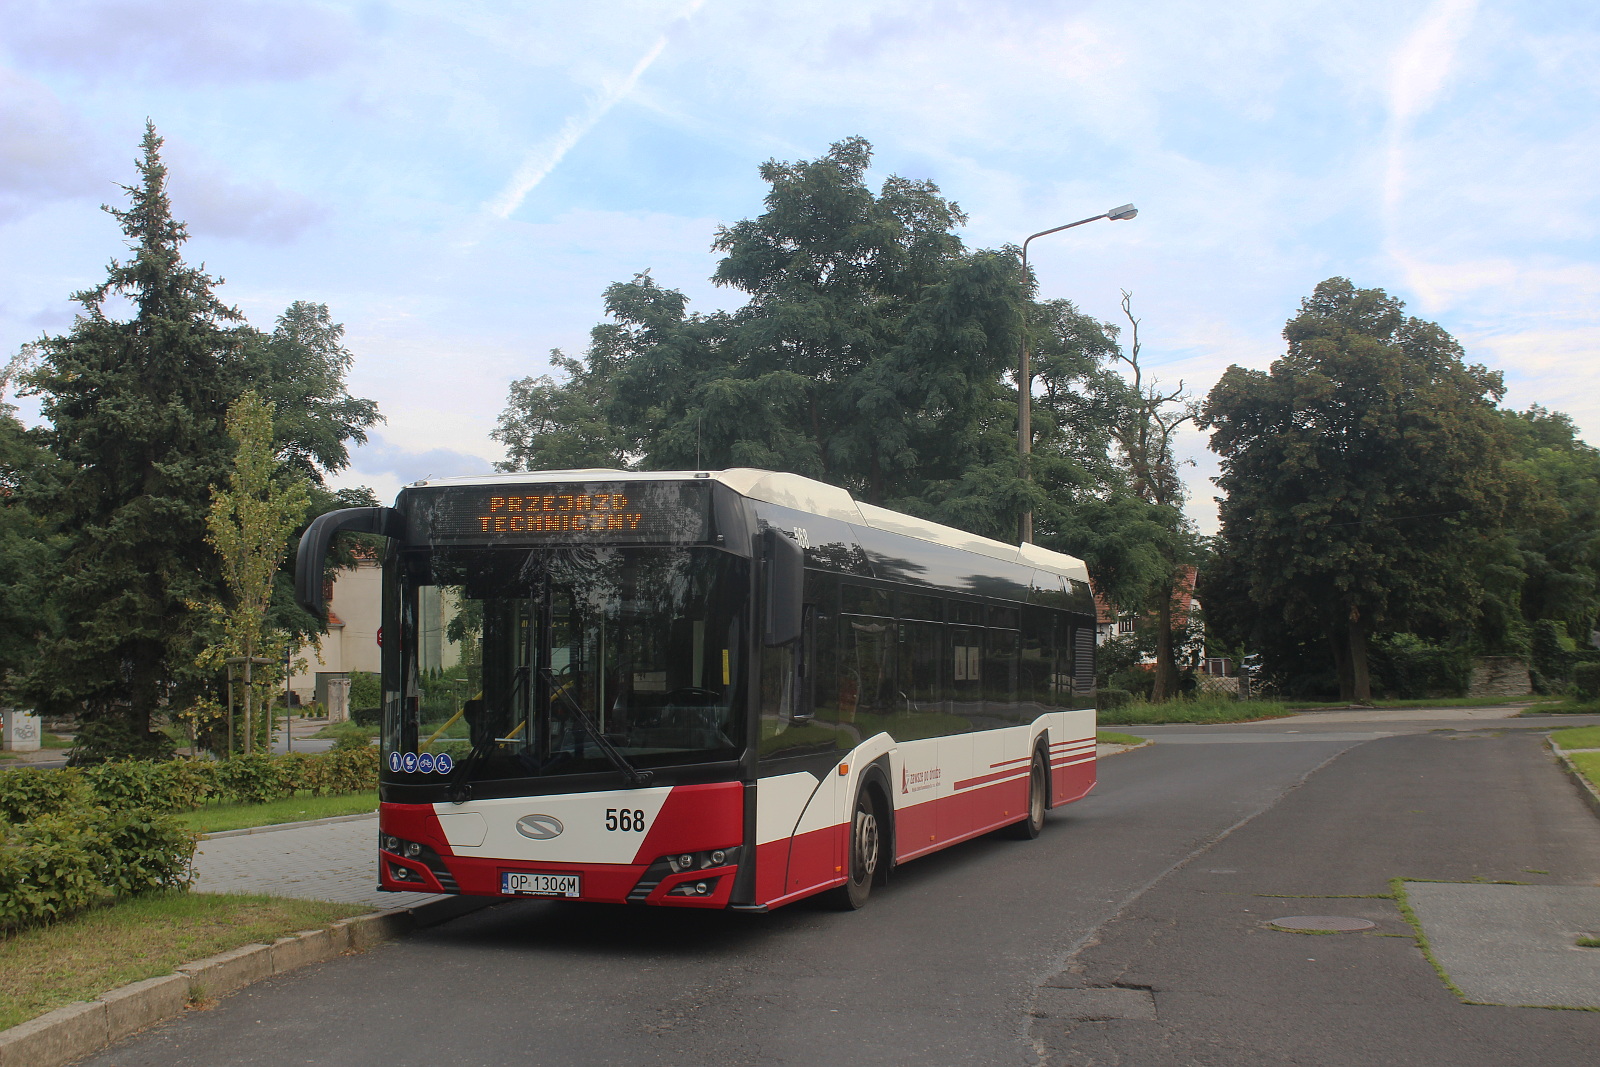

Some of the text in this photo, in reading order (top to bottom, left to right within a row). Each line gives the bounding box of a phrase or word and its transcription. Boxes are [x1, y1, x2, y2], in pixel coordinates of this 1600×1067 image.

[490, 494, 628, 512] PRZEJAZD
[478, 513, 642, 532] TECHNICZNY
[605, 808, 645, 832] 568
[510, 875, 576, 892] OP 1306M
